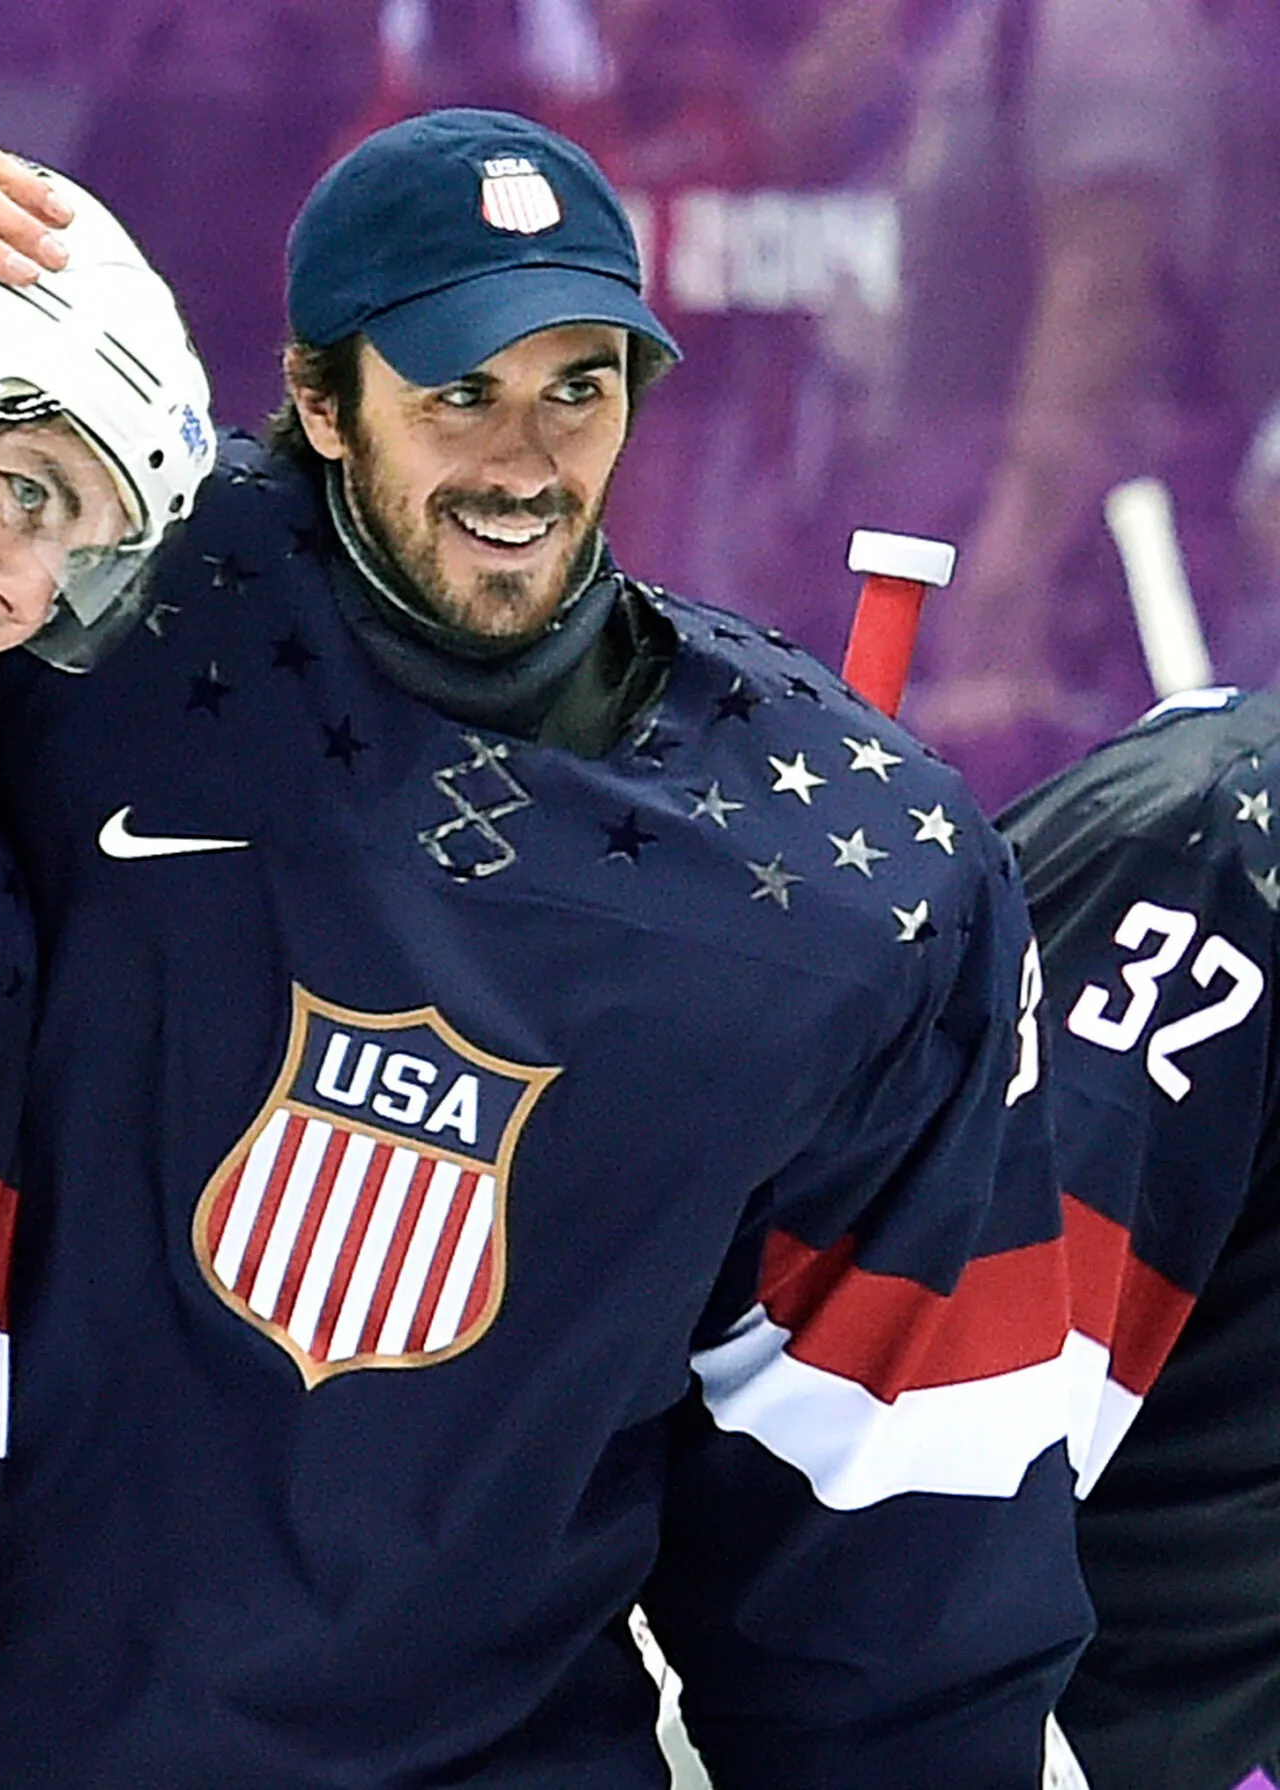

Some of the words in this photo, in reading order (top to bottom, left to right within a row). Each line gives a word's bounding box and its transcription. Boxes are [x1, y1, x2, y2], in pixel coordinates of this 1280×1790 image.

[670, 194, 901, 312] 2014
[1067, 900, 1265, 1103] 32
[315, 1032, 478, 1144] USA
